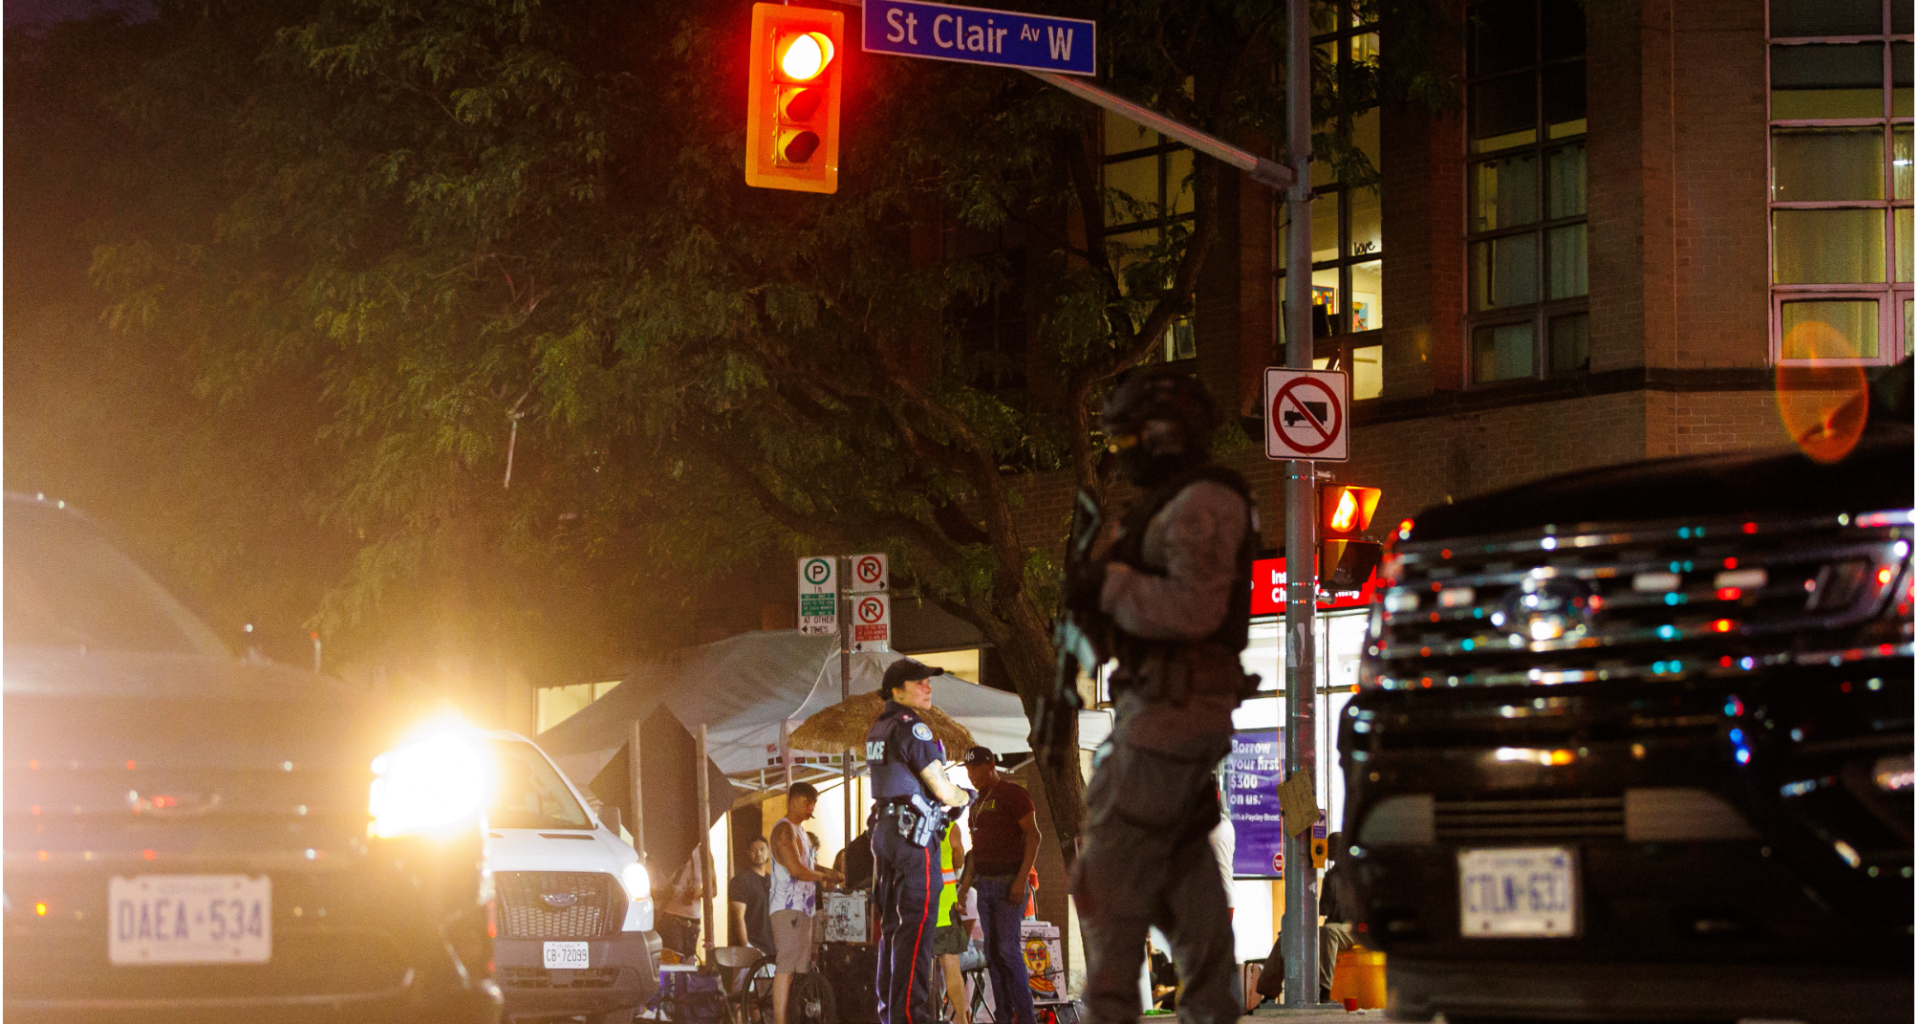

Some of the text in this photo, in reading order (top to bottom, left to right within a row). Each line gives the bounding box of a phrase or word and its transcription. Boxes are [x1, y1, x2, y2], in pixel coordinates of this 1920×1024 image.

[886, 8, 1074, 61] St Clair Av W
[812, 565, 824, 580] P
[810, 625, 829, 634] TIMES
[1231, 739, 1271, 754] Borrow
[1230, 755, 1279, 772] your first
[1230, 774, 1258, 790] $300
[1230, 794, 1244, 805] on
